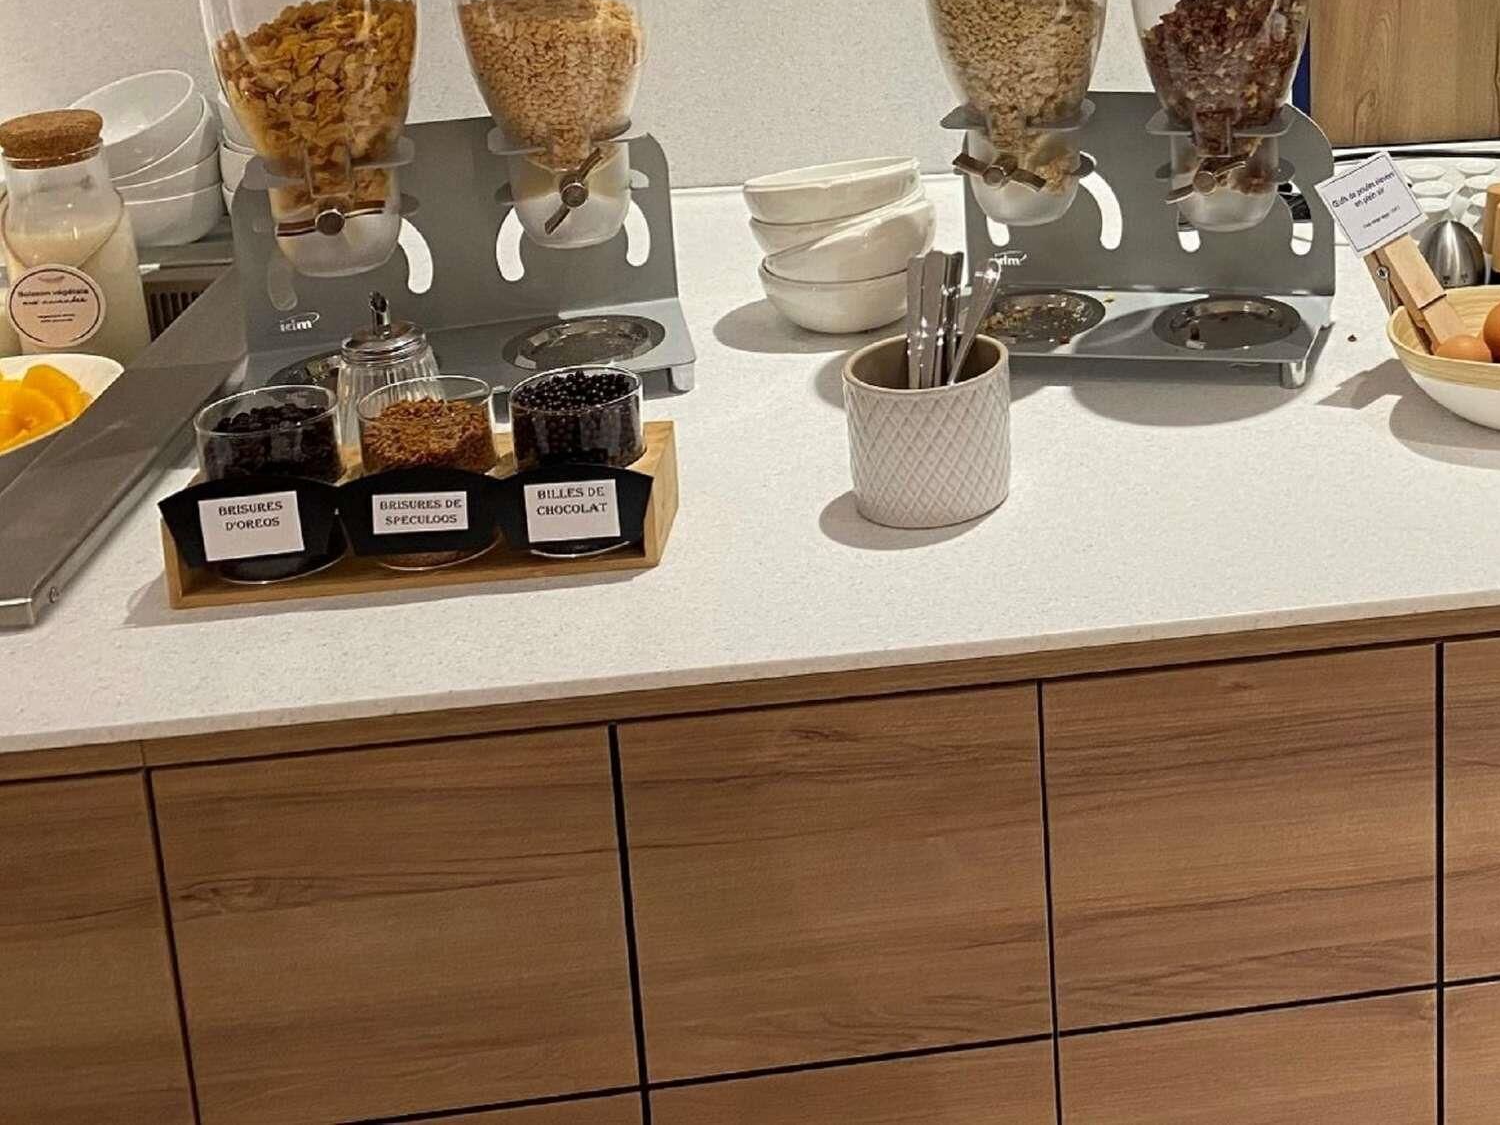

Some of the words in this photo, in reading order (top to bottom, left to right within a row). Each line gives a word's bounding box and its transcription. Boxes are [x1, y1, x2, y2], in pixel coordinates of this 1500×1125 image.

[537, 487, 584, 500] BILLES
[587, 486, 605, 498] DE
[218, 501, 283, 517] BRISURES
[379, 499, 441, 510] BRISURES
[445, 498, 462, 509] DE
[536, 502, 608, 516] CHOCOLAT
[225, 517, 280, 532] D'OREOS
[385, 514, 457, 526] SPECULOOS
